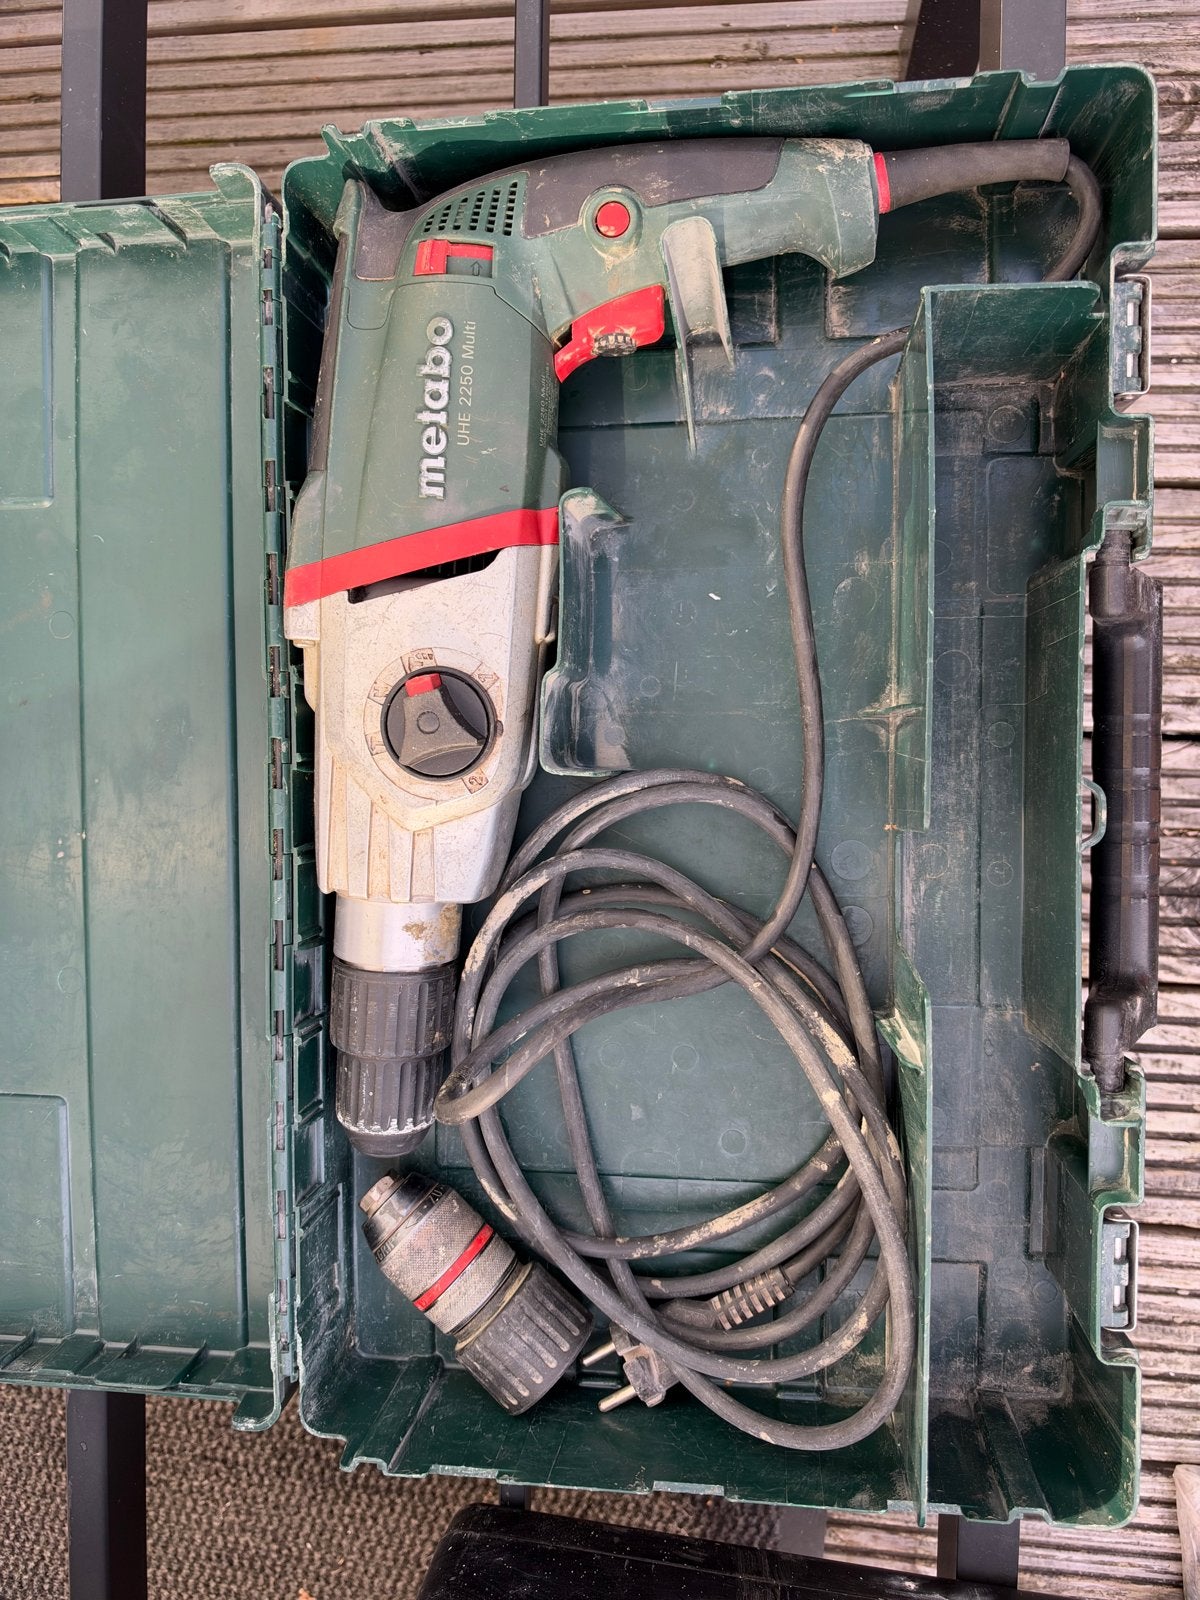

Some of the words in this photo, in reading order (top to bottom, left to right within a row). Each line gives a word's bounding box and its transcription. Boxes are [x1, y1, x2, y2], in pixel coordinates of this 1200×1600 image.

[461, 320, 476, 360] Multi
[459, 365, 473, 407] 2250
[415, 317, 454, 500] metabo
[457, 412, 471, 446] UHE
